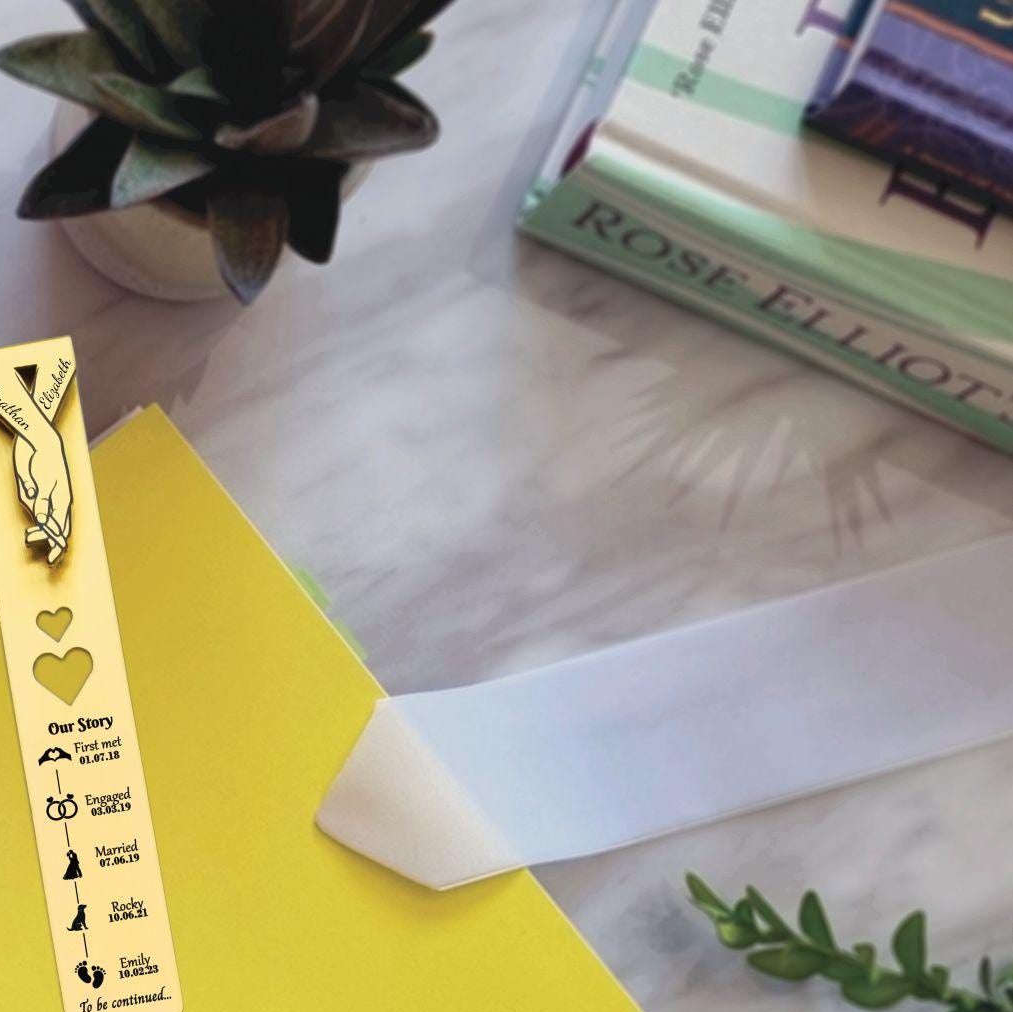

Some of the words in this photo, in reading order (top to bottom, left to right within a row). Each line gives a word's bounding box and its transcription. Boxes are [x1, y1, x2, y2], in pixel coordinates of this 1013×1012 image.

[572, 197, 749, 297] ROSE
[755, 283, 1013, 426] ELLIOT
[39, 358, 72, 411] Elizabeth
[48, 722, 75, 735] Our
[77, 715, 114, 732] Story
[74, 741, 100, 754] First
[101, 736, 123, 749] met
[79, 750, 120, 765] 01.07.18
[85, 786, 132, 807] Engaged
[91, 802, 132, 817] 03.03.19
[95, 838, 139, 858] Married
[99, 853, 140, 868] 07.06.19
[111, 897, 144, 913] Rocky
[108, 908, 149, 923] 10.06.21
[119, 952, 151, 969] Emily
[118, 964, 159, 979] 10.02.23
[96, 996, 108, 1011] be
[111, 985, 172, 1009] continued...
